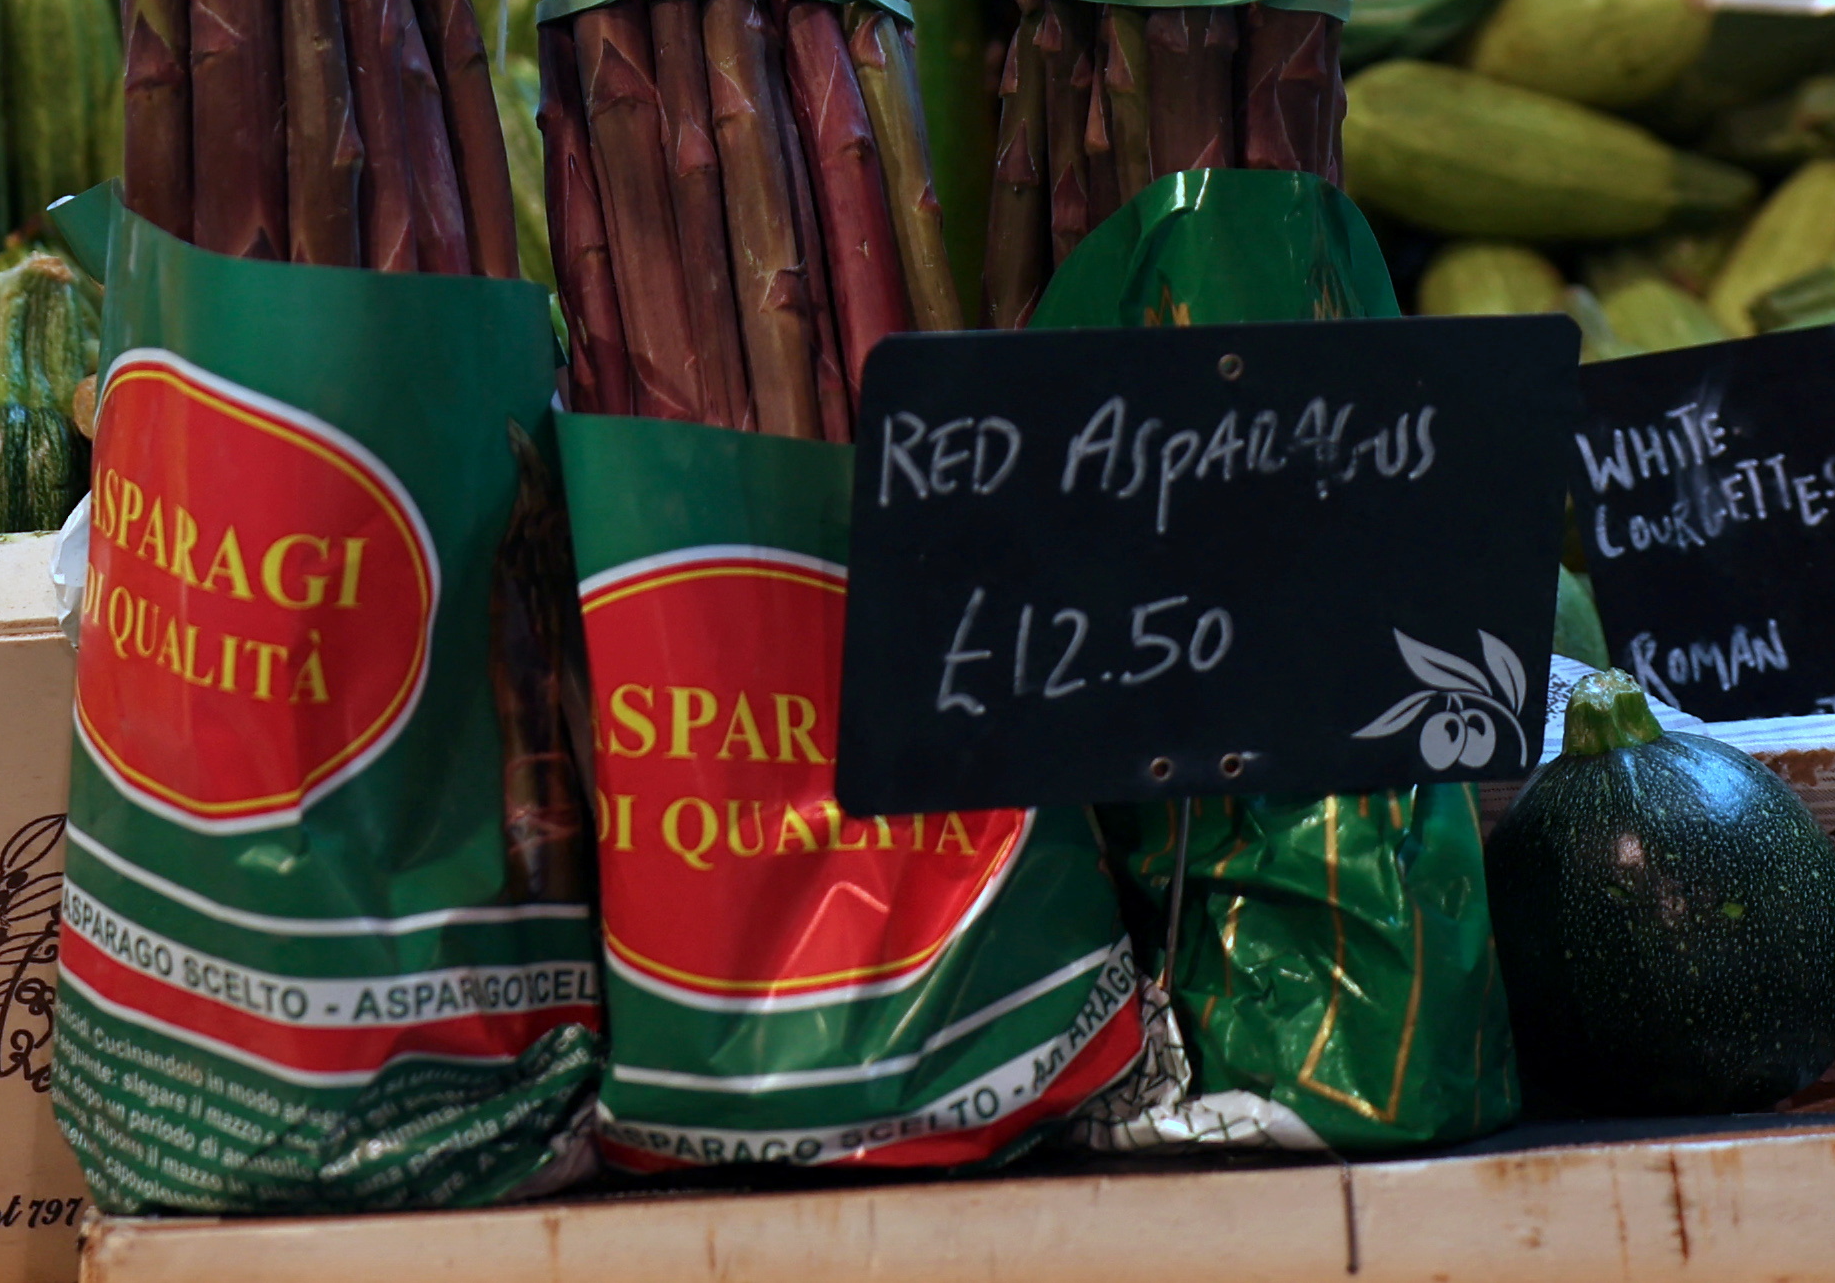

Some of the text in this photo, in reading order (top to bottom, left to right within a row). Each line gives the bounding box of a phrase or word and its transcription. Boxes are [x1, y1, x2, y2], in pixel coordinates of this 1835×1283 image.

[879, 411, 1022, 507] RED
[1575, 401, 1728, 495] WHITE
[108, 585, 331, 704] QUALITÀ
[936, 586, 1234, 716] £12.50
[1630, 617, 1790, 711] ROMAN
[184, 958, 308, 1021] SCELTO
[127, 1109, 196, 1152] periodo
[204, 1105, 263, 1145] mazzo
[28, 1195, 85, 1229] 797
